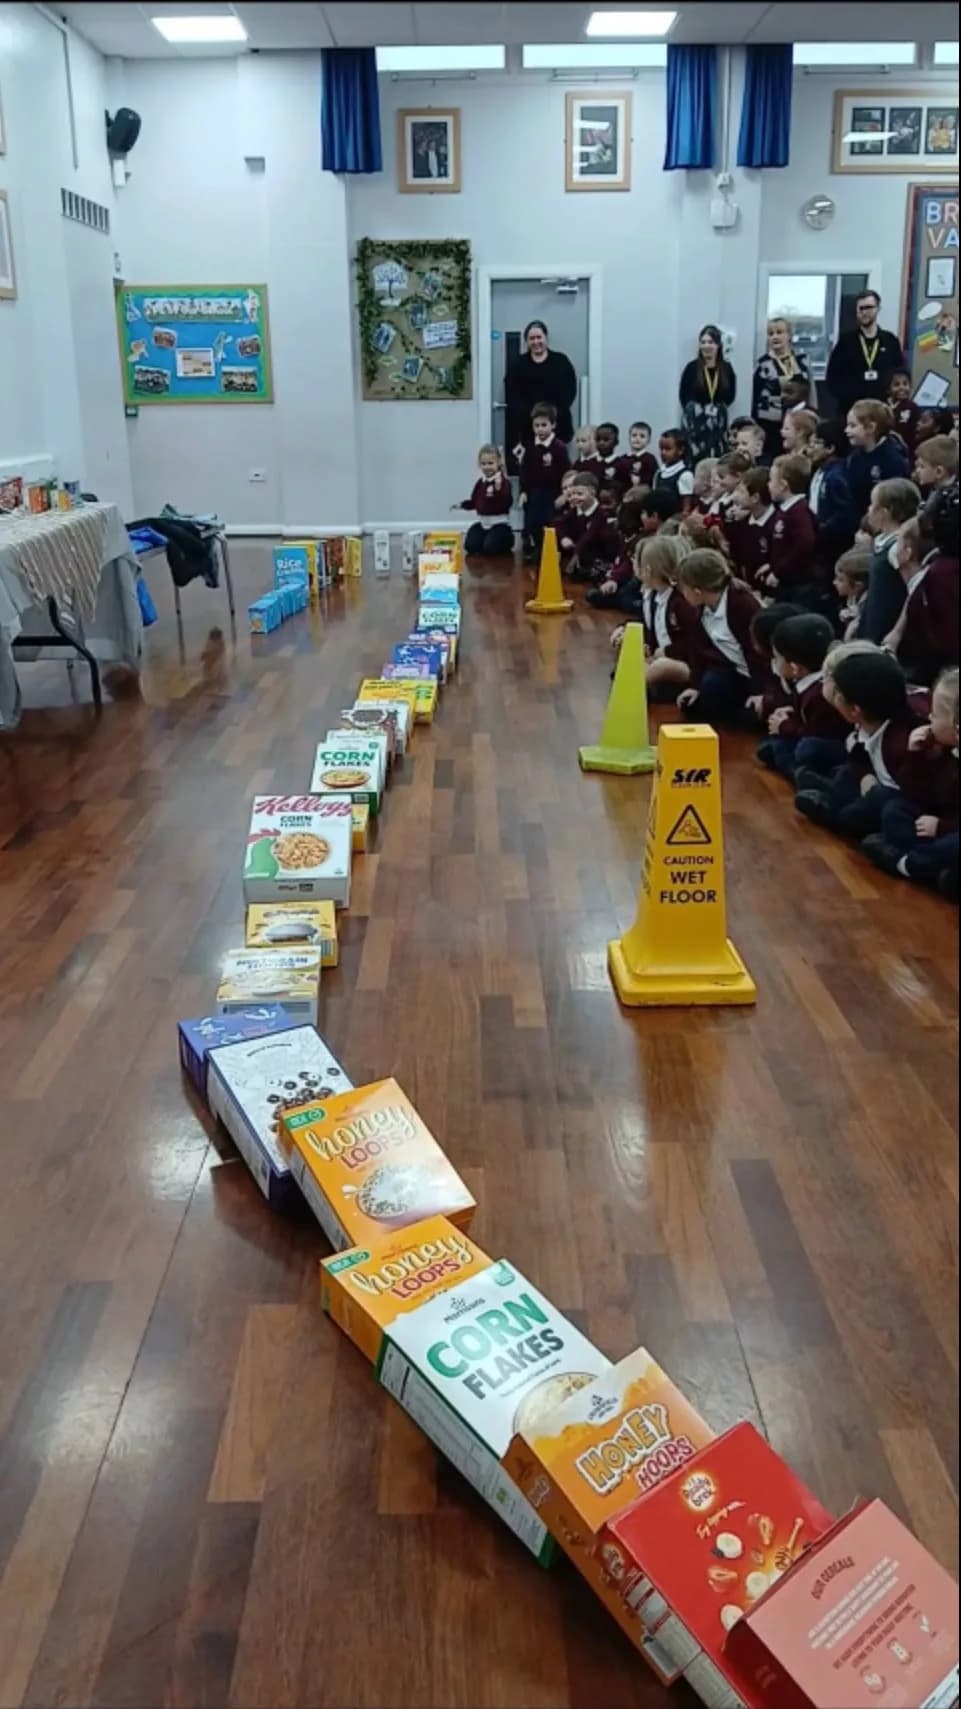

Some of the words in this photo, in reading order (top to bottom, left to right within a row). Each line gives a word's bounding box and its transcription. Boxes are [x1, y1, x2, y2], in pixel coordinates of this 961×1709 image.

[320, 751, 376, 761] CORN
[672, 768, 711, 784] SIR
[280, 815, 313, 823] CORN
[663, 855, 714, 866] CAUTION
[670, 870, 707, 884] WET
[660, 890, 717, 904] FLOOR
[304, 1104, 417, 1161] honey
[341, 1132, 403, 1169] LOOPS
[350, 1236, 474, 1296] honey
[391, 1257, 462, 1299] LOOPS
[426, 1293, 549, 1378] CORN
[462, 1328, 565, 1400] FLAKES
[577, 1404, 671, 1494] HONEY
[637, 1435, 696, 1490] HOOPS
